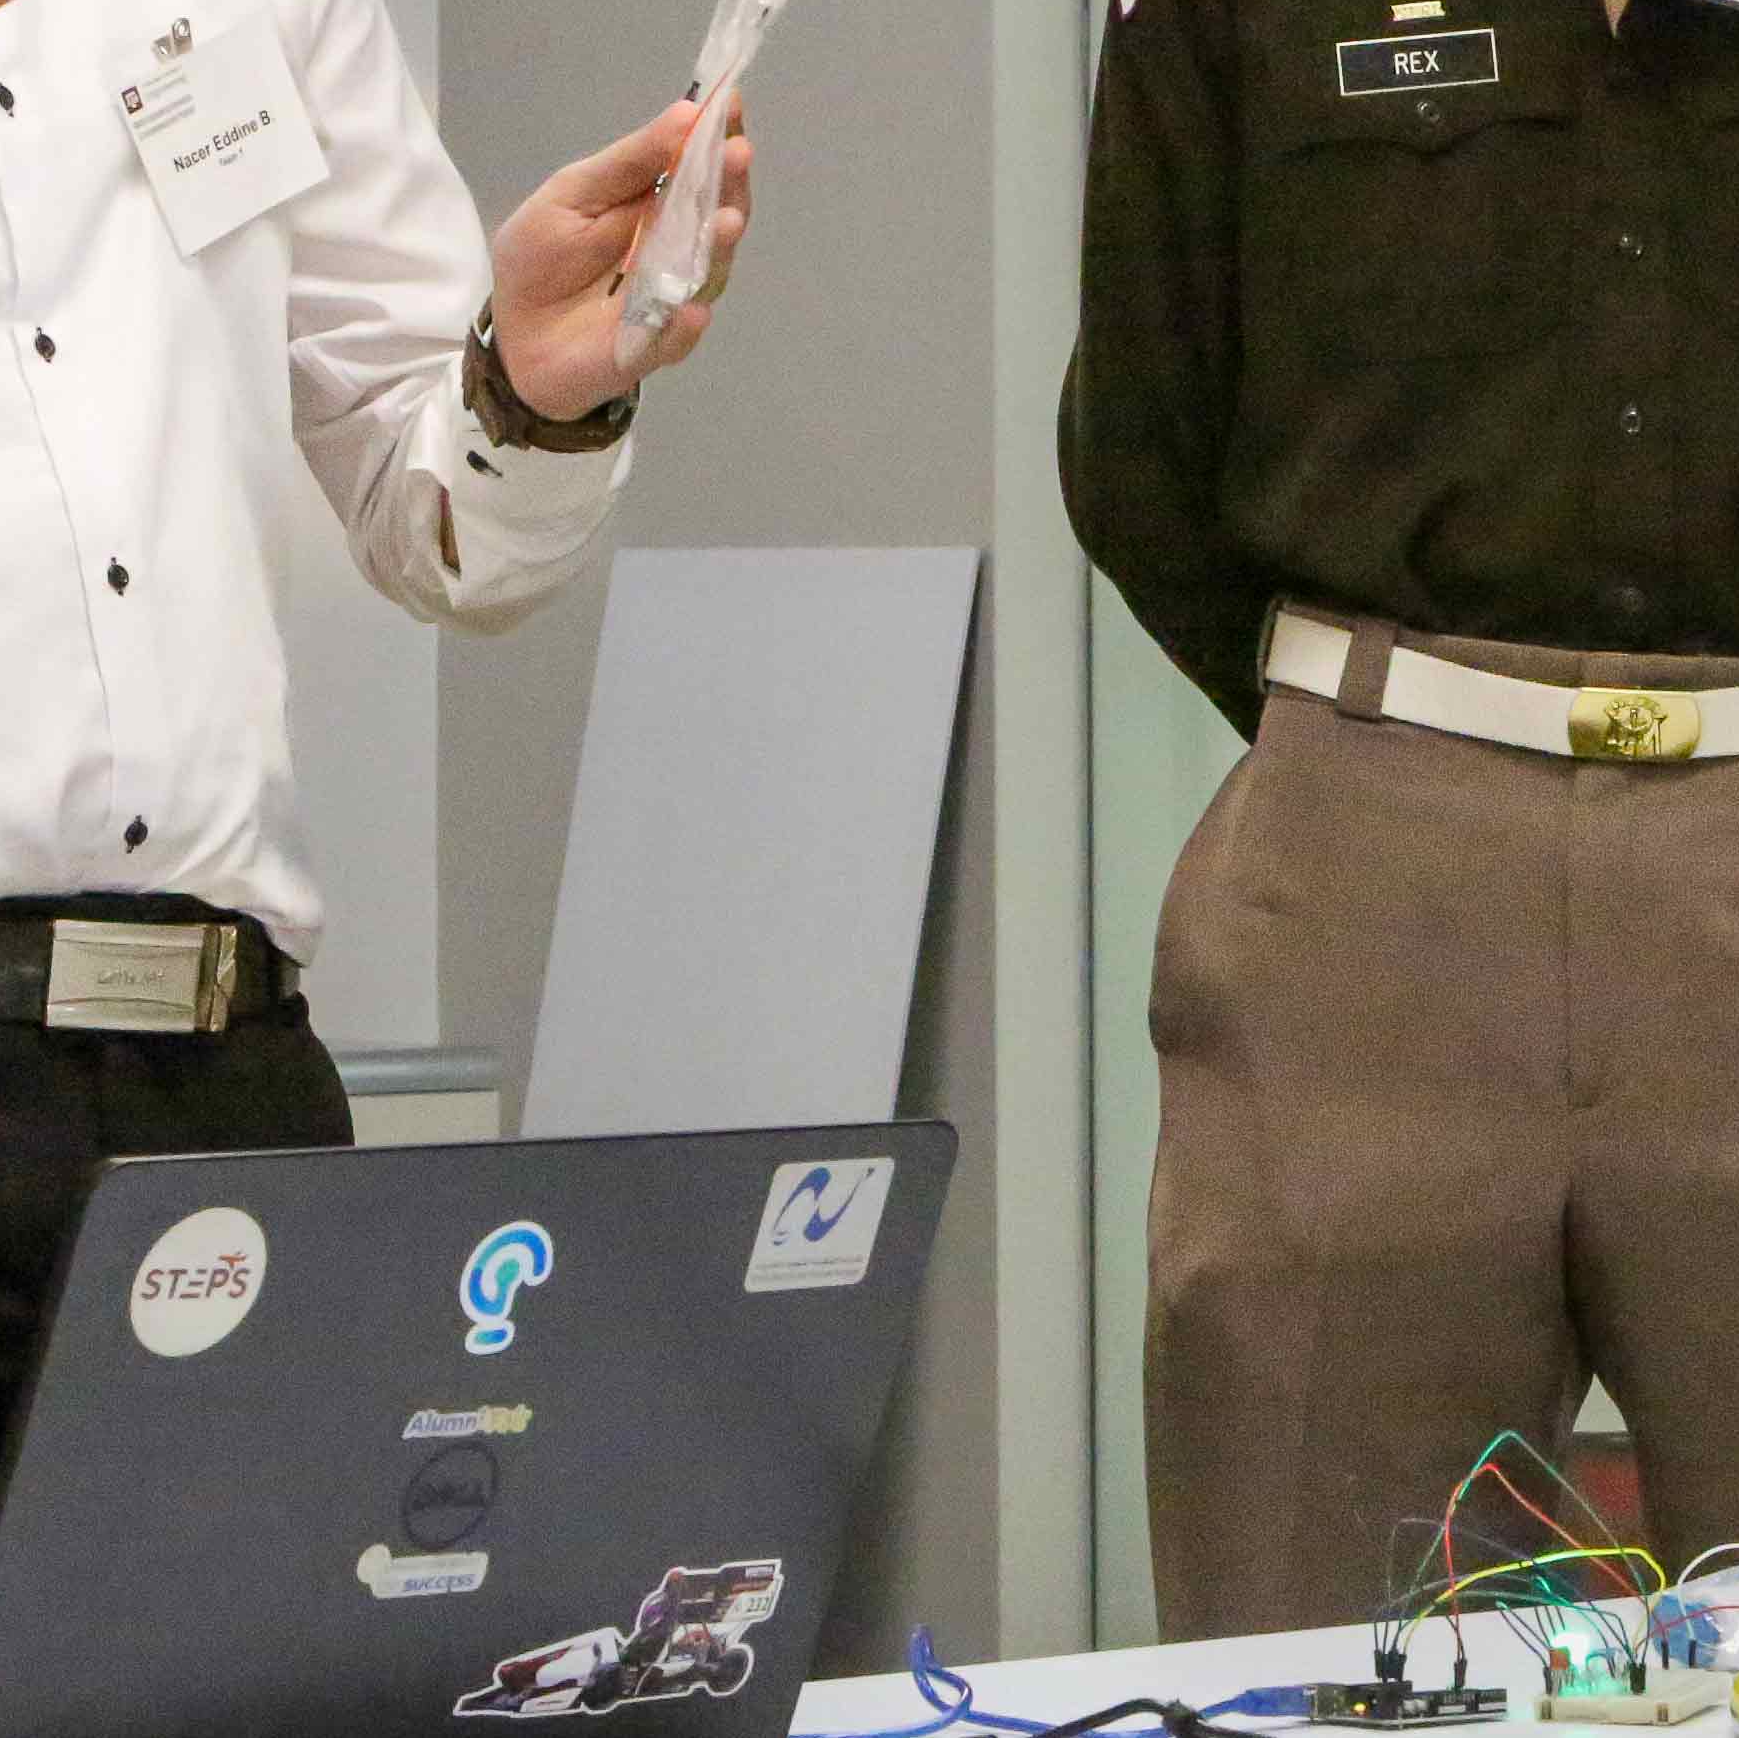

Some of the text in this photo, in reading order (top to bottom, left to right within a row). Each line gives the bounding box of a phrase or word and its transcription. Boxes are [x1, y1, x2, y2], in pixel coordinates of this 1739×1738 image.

[1393, 49, 1440, 76] REX
[173, 144, 211, 173] Nacer
[212, 118, 260, 152] Eddine
[140, 1267, 250, 1300] STEPS
